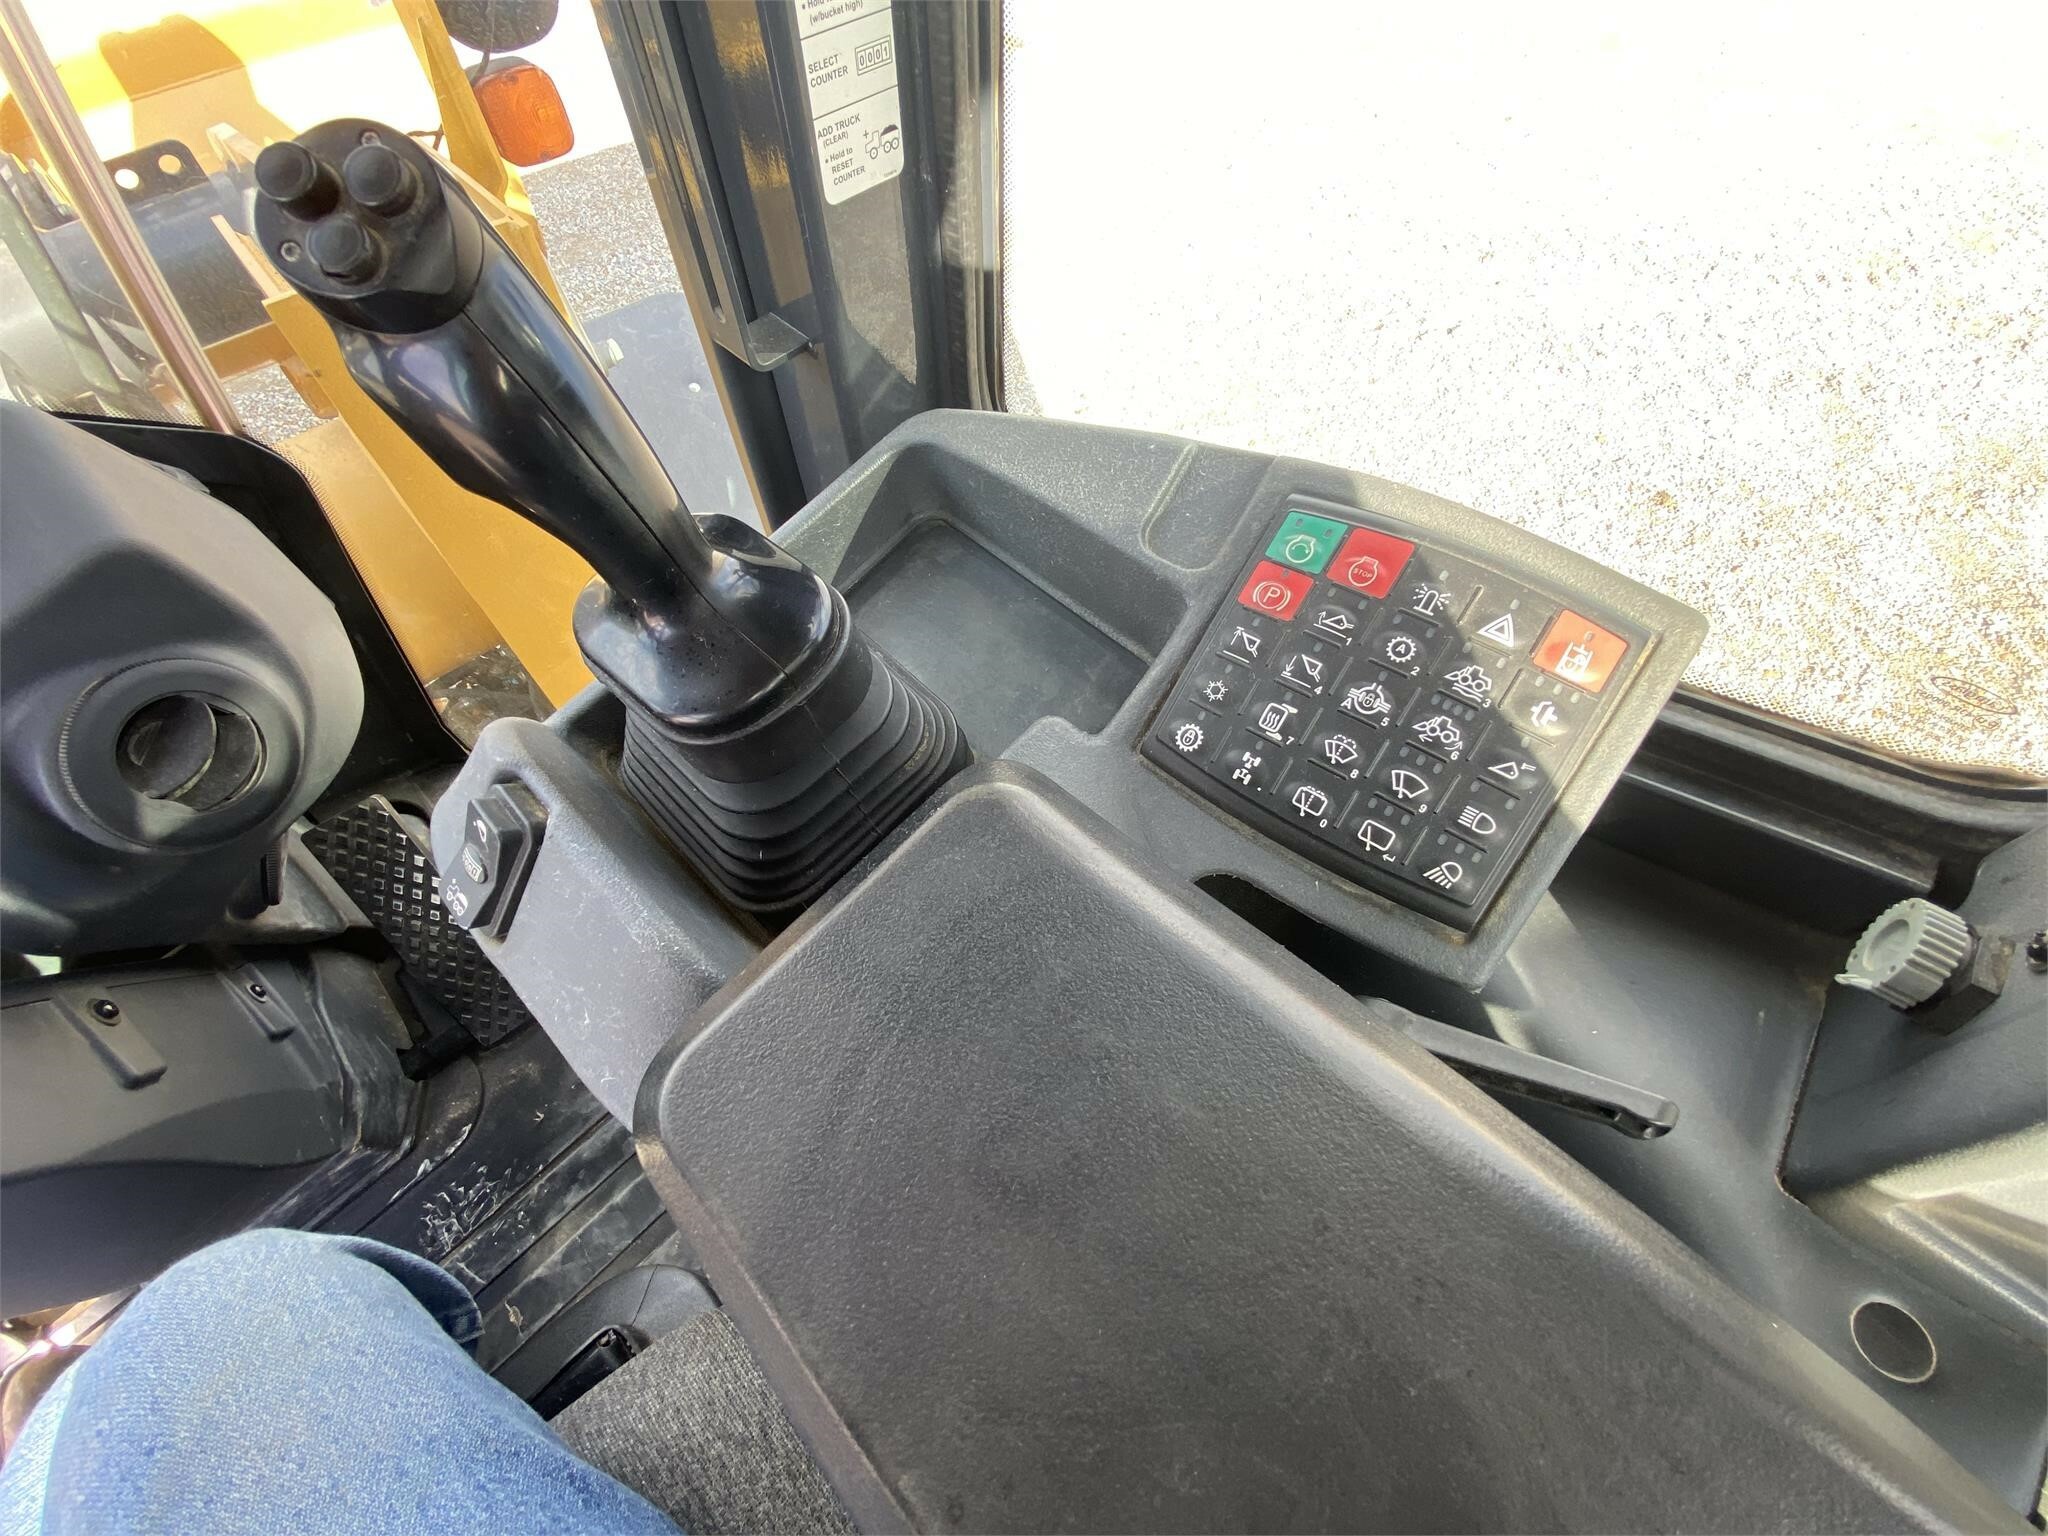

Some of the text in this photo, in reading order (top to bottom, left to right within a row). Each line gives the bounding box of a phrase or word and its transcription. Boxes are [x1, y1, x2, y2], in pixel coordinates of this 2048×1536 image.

[859, 46, 888, 66] 0001
[808, 53, 839, 74] SELECT
[810, 65, 848, 88] COUNTER
[818, 113, 861, 139] ADD TRUCK
[823, 130, 849, 149] (CLEAR)
[830, 147, 853, 162] Hold to
[831, 158, 853, 174] RESET
[833, 165, 866, 185] COUNTER
[1353, 567, 1373, 578] STOP
[1263, 587, 1281, 603] P
[1345, 637, 1353, 646] 1
[1395, 643, 1406, 654] A
[1410, 666, 1420, 676] 2
[1314, 685, 1323, 695] 4
[1340, 698, 1351, 710] A
[1482, 698, 1492, 708] 3
[1380, 717, 1390, 727] 5
[1286, 736, 1295, 745] 7
[1450, 750, 1459, 760] 6
[1350, 769, 1359, 779] 8
[1418, 804, 1428, 814] 9
[1319, 818, 1328, 828] 0
